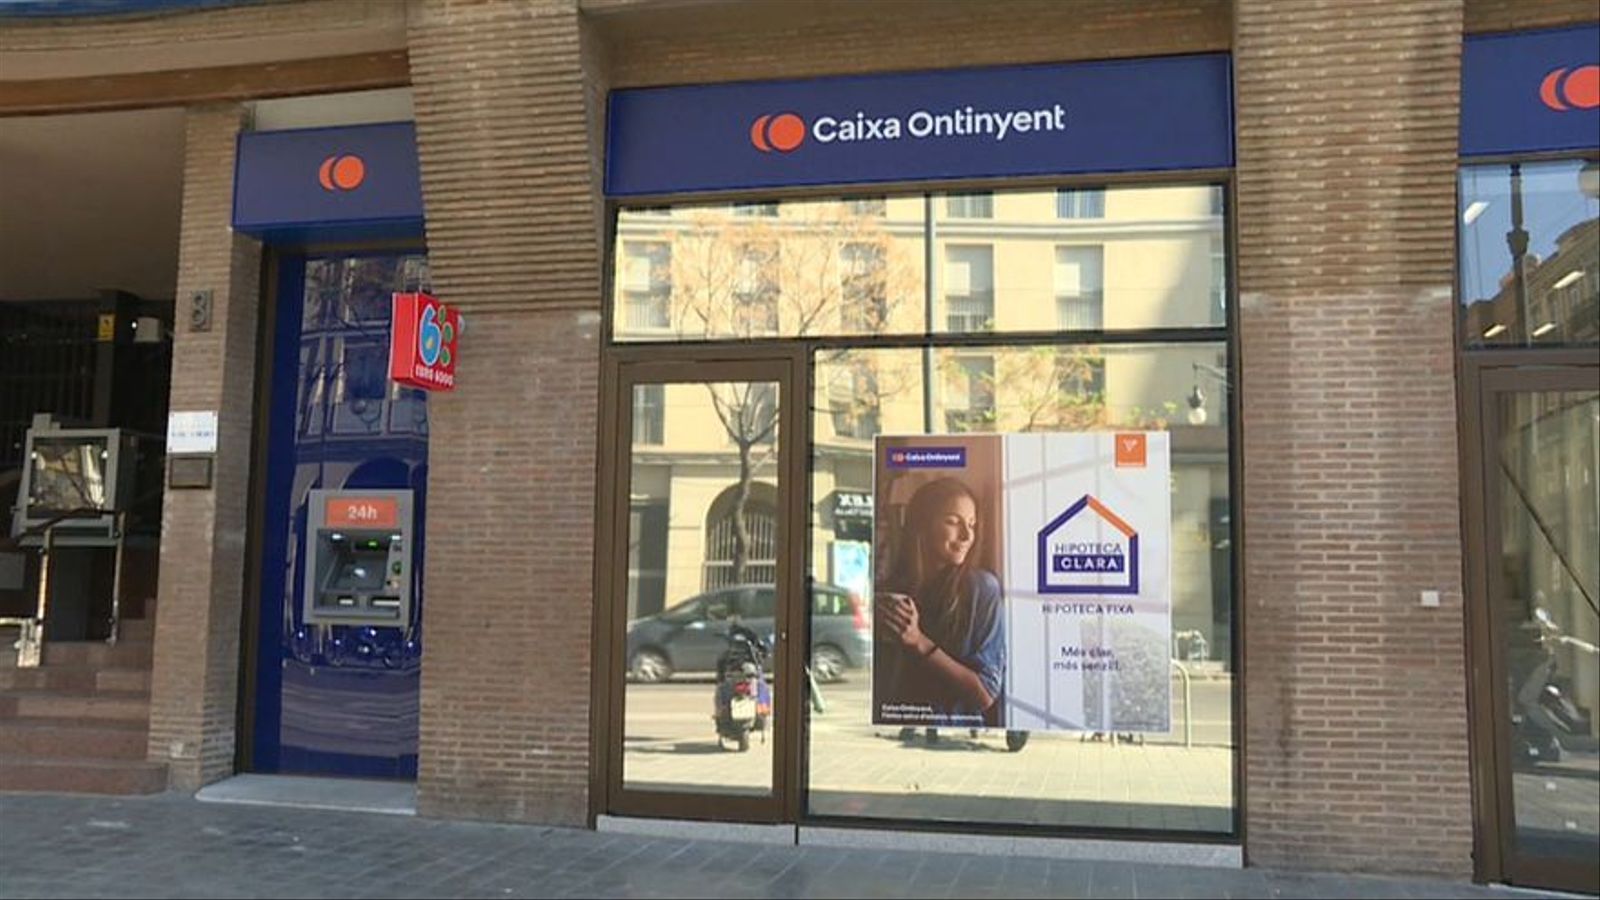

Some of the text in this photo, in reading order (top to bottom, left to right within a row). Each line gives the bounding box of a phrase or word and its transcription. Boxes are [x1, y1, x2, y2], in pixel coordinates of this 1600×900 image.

[812, 104, 1066, 142] Caixa Ontinyent
[348, 505, 378, 520] 24h
[1054, 542, 1123, 554] HIPOTECA
[1060, 557, 1119, 570] CLARA
[1042, 603, 1134, 614] HIPOTECA FIXA
[1061, 645, 1087, 658] Més
[1053, 659, 1078, 671] més
